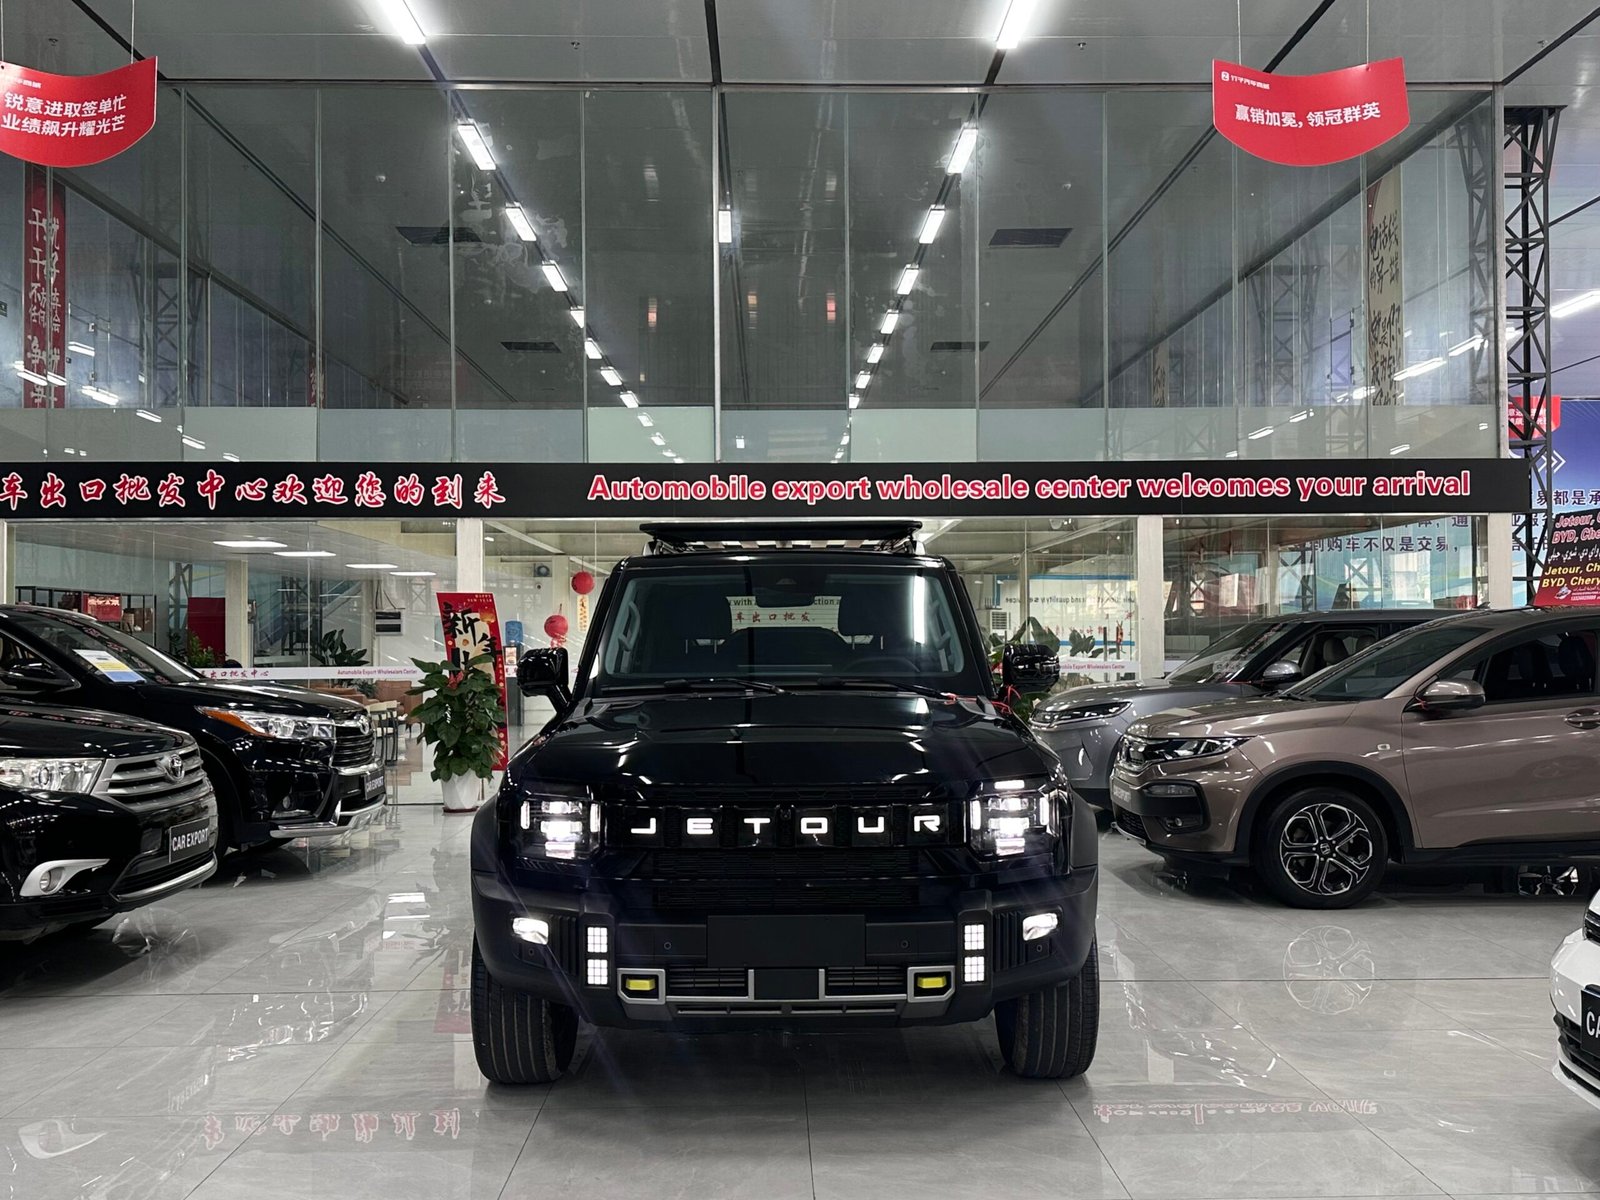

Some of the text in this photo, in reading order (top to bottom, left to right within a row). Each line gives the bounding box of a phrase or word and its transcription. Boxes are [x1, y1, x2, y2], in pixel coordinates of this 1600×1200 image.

[4, 91, 127, 118] 锐意进取签单忙
[1, 112, 126, 137] 业绩飙升耀光芒
[0, 470, 506, 510] 车出口批发中心欢迎您的到来
[587, 471, 1471, 505] Automobile export wholesale center welcomes your arrival
[1555, 514, 1595, 528] Jetour,
[1551, 529, 1579, 544] BYD,
[1544, 566, 1583, 576] Jetour,
[734, 598, 752, 606] with
[735, 611, 810, 623] 车出口批发
[630, 815, 941, 835] JETOUR
[172, 827, 209, 852] CAR EXPORT
